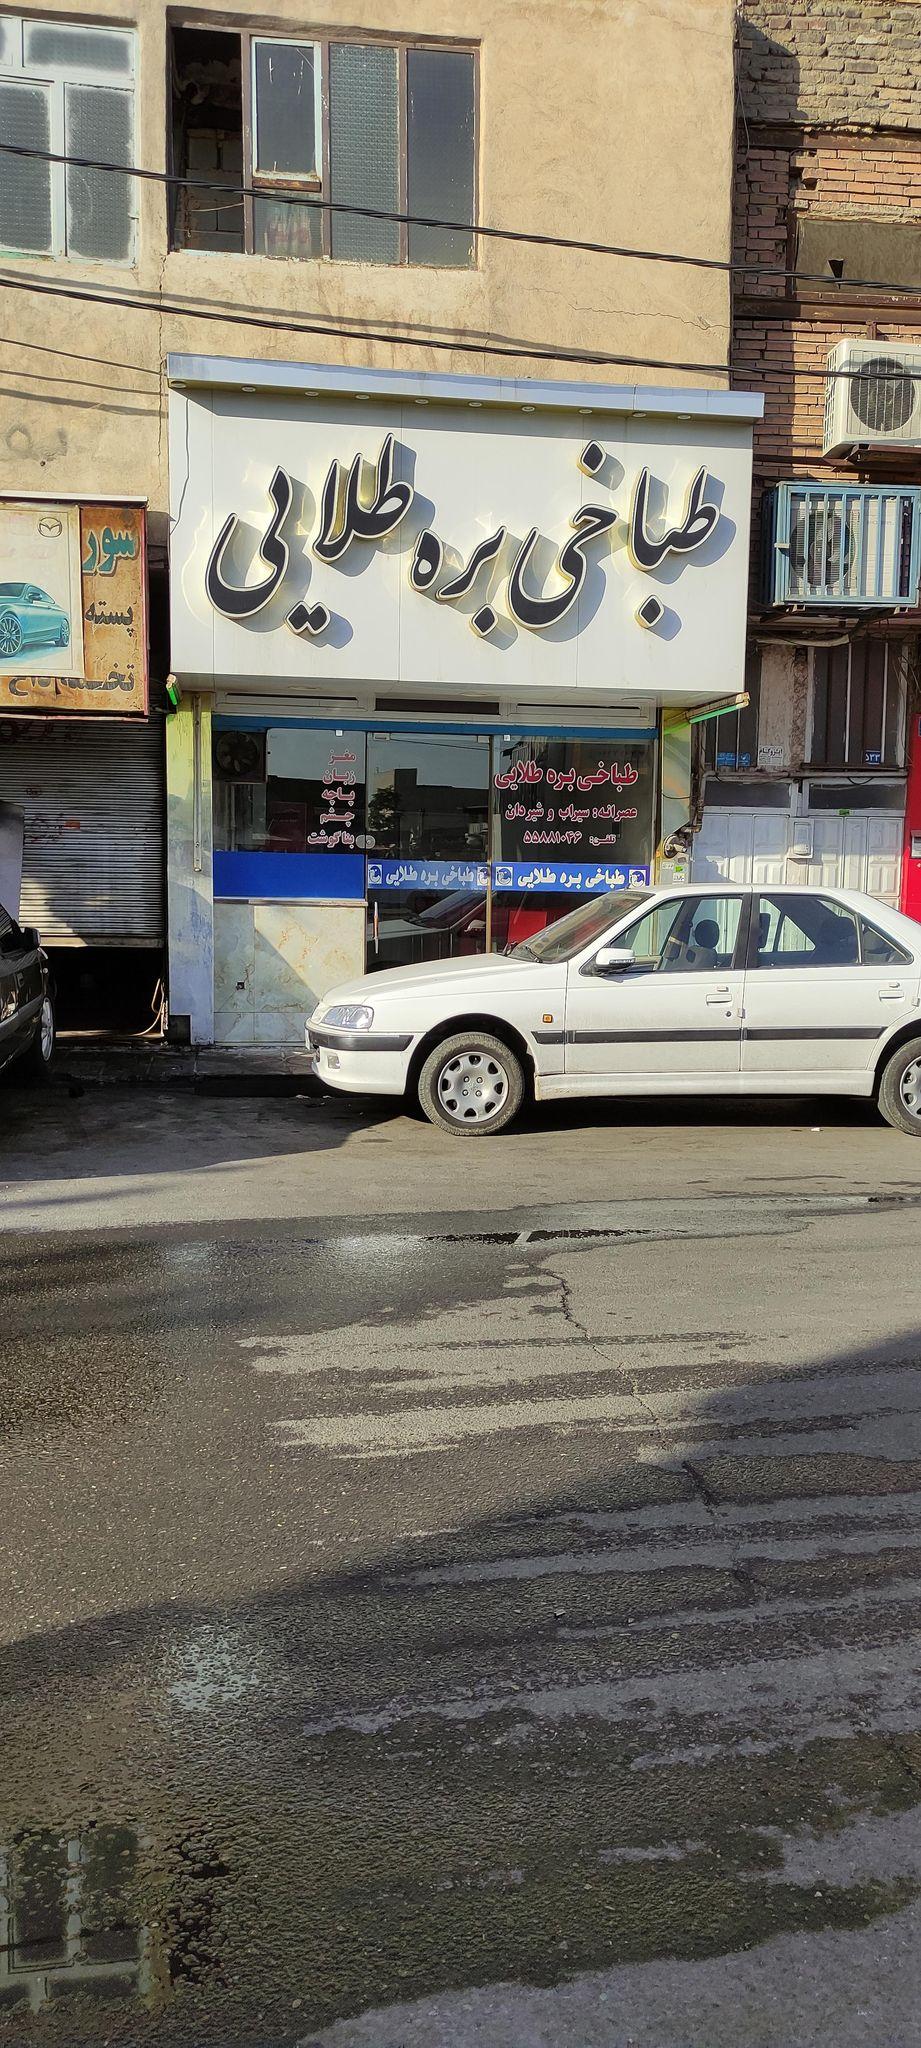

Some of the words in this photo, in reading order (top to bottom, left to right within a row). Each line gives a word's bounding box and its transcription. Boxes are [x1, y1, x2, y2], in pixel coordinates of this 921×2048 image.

[204, 432, 415, 636] طلایی
[505, 440, 722, 630] طباخی
[408, 526, 507, 638] بره
[84, 600, 134, 637] پسته
[328, 749, 356, 765] مغز
[322, 768, 356, 785] زبان
[494, 760, 543, 790] طلایی
[546, 768, 577, 791] بره
[577, 761, 638, 792] طباخی
[321, 787, 355, 806] پاچه
[320, 807, 355, 827] چشم
[546, 808, 555, 822] و
[558, 803, 590, 822] سیراب
[386, 865, 418, 886] طلایی
[421, 869, 439, 886] بره
[441, 865, 474, 886] طباخی
[517, 867, 556, 889] طلایی
[559, 871, 582, 889] بره
[585, 868, 625, 889] طباخی
